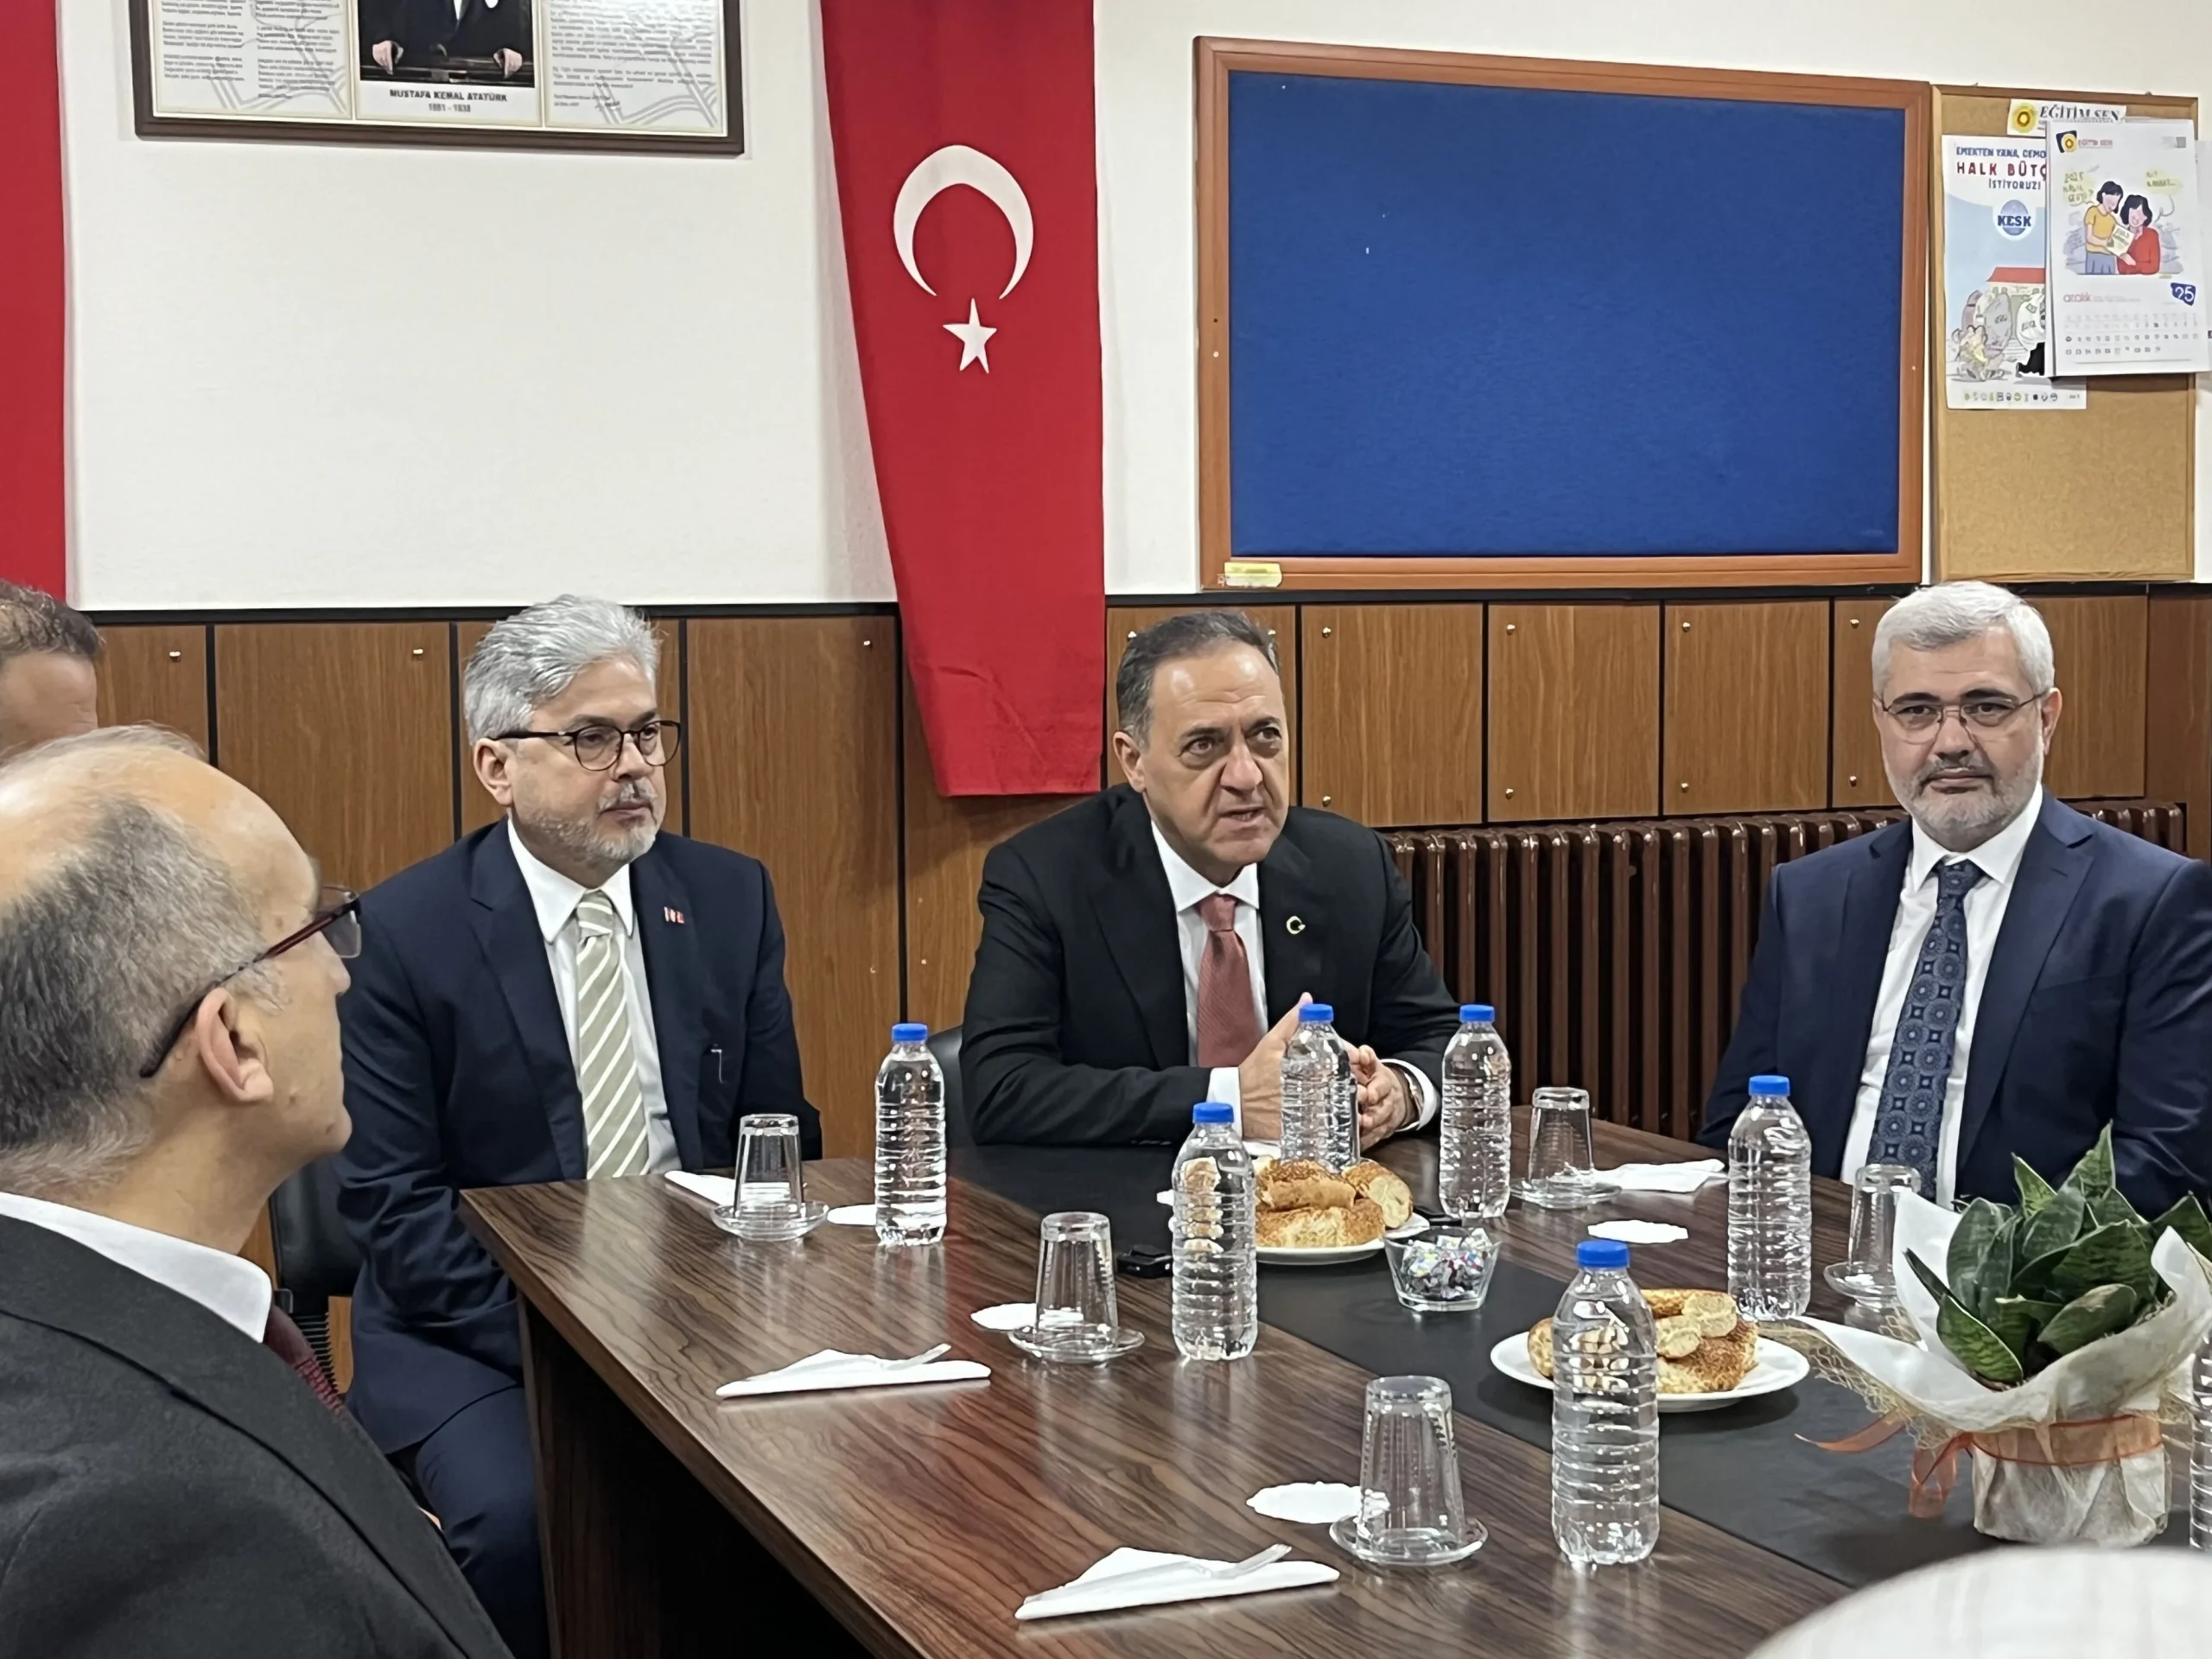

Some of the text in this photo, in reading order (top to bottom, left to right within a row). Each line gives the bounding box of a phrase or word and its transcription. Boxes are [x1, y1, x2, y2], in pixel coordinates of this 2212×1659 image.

[390, 89, 507, 102] MUSTAFA KEMAL ATATÜRK
[429, 103, 446, 111] 1881
[1956, 146, 1994, 157] EMEKTEN
[1956, 161, 1998, 176] HALK
[1988, 178, 2041, 190] İSTİYORUZ!
[1997, 215, 2031, 227] KESK
[2175, 286, 2195, 302] 25
